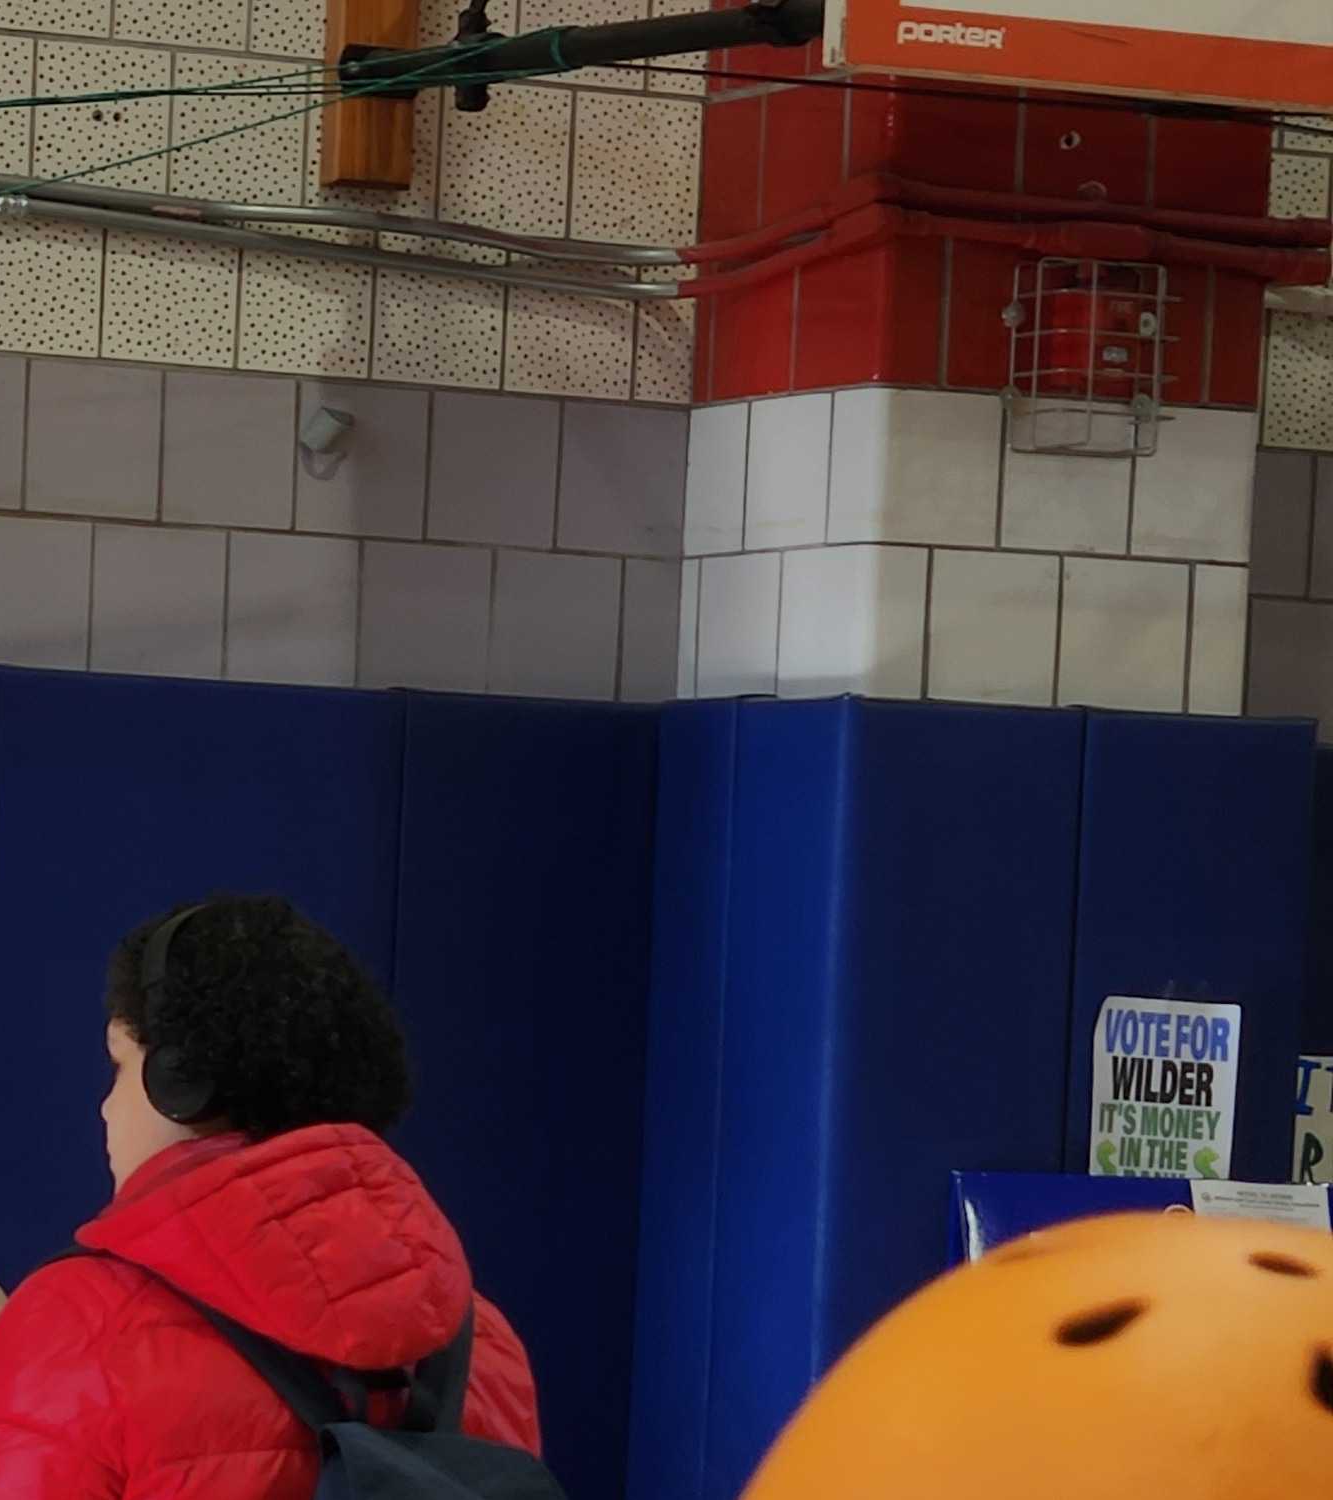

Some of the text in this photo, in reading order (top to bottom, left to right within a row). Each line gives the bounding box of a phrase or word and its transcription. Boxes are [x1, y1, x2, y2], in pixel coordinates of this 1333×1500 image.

[1106, 1008, 1230, 1062] VOTE FOR
[1112, 1056, 1214, 1107] WILDER
[1099, 1102, 1221, 1140] IT'S MONEY
[1119, 1137, 1189, 1171] IN THE
